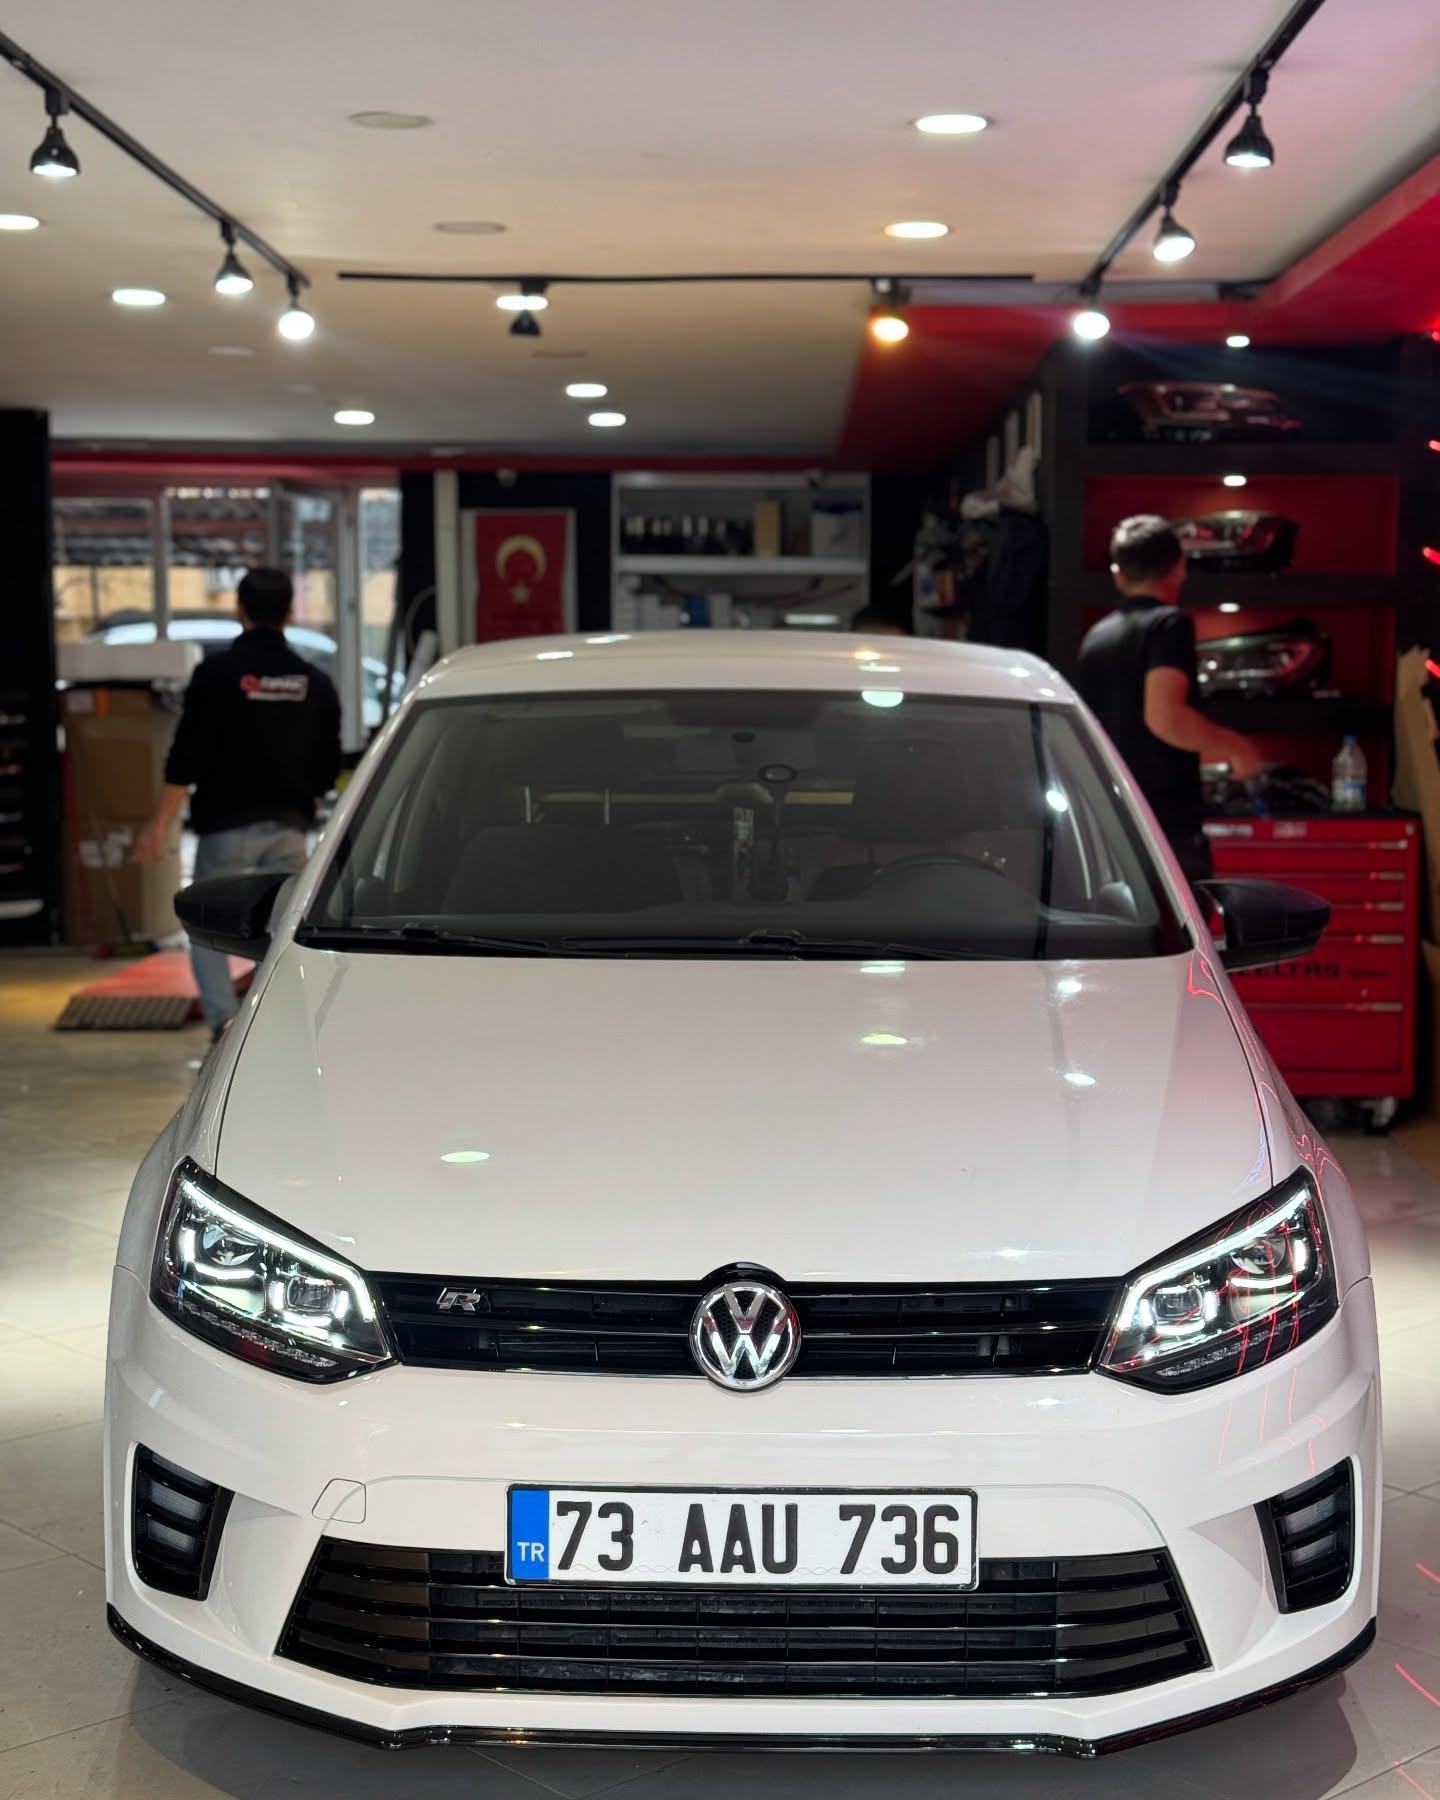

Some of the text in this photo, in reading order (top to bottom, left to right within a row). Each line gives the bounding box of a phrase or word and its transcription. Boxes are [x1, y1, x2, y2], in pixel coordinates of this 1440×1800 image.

[700, 1286, 790, 1382] VW
[517, 1542, 545, 1562] TR
[556, 1501, 960, 1574] 73 AAU 736
